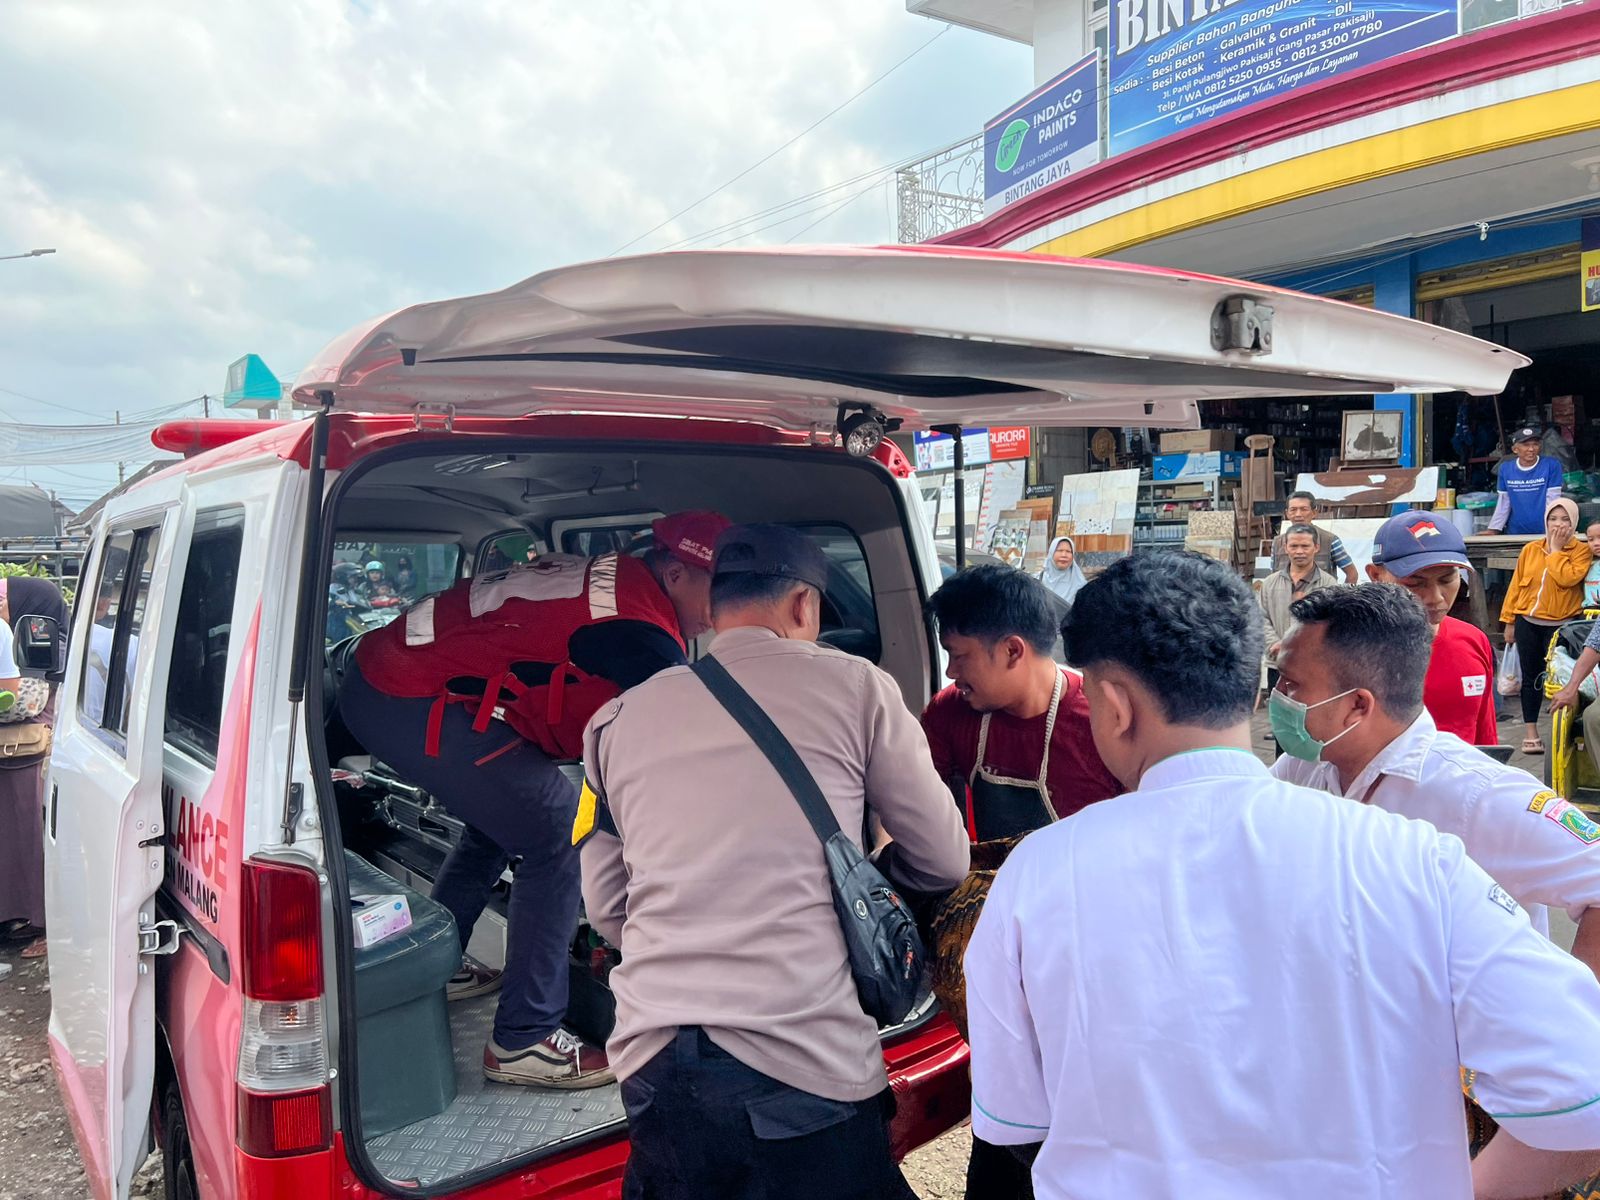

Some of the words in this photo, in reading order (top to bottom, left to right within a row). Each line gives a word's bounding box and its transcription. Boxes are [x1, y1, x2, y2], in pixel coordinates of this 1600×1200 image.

[1113, 78, 1139, 95] Sedia
[1152, 61, 1173, 79] Besi
[1175, 51, 1205, 70] Beton
[1220, 23, 1271, 50] Galvalum
[1146, 39, 1193, 67] Supplier
[1196, 21, 1236, 46] Bahan
[1152, 74, 1173, 91] Besi
[1175, 63, 1204, 82] Kotak
[1220, 37, 1266, 63] Keramik
[1268, 32, 1277, 43] &
[1279, 17, 1316, 39] Granit
[1157, 100, 1177, 113] Telp
[1184, 89, 1202, 102] WA
[1204, 79, 1227, 95] 0812
[1228, 69, 1253, 86] 5250
[1255, 57, 1282, 75] 0935
[1291, 44, 1317, 61] 0812
[1319, 32, 1349, 52] 3300
[1351, 19, 1383, 39] 7780
[1172, 81, 1192, 95] Panji
[1193, 64, 1239, 87] Pulangjiwo
[1240, 47, 1273, 68] Pakisaji
[1275, 39, 1303, 56] (Gang
[1304, 27, 1331, 43] Pasar
[1333, 9, 1375, 32] Pakisaji)
[1277, 71, 1304, 88] Harga
[1303, 62, 1320, 77] dan
[1320, 50, 1359, 73] Layanan
[1033, 88, 1083, 129] INDACO
[1038, 110, 1077, 144] PAINTS
[1012, 164, 1026, 177] NOW
[1025, 158, 1037, 169] FOR
[1037, 139, 1069, 163] TOMORROW
[1004, 173, 1045, 204] BINTANG
[1046, 159, 1071, 185] JAYA
[990, 429, 1026, 444] AURORA
[177, 861, 218, 924] MALANG
